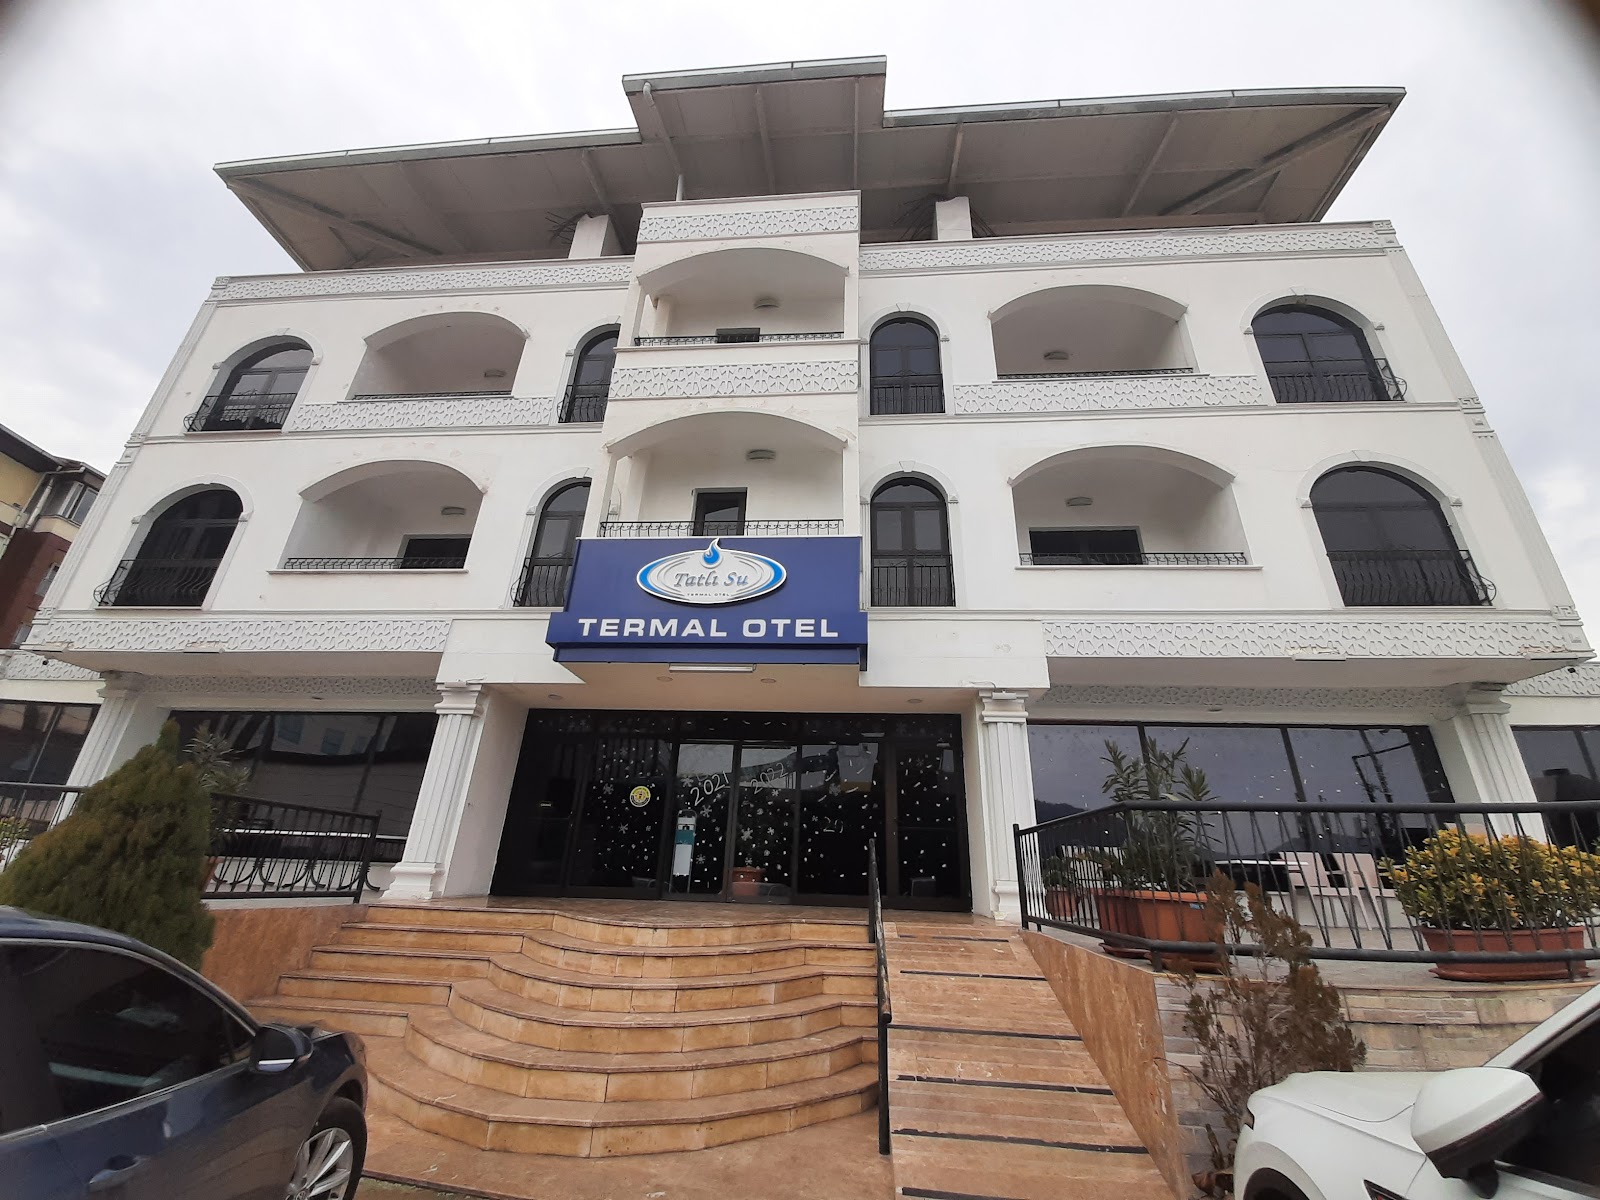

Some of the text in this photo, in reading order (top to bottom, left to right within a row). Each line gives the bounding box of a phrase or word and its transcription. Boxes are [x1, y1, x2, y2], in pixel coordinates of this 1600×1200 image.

[723, 571, 749, 587] Su
[578, 618, 839, 638] TERMAL OTEL
[689, 770, 730, 807] 2021
